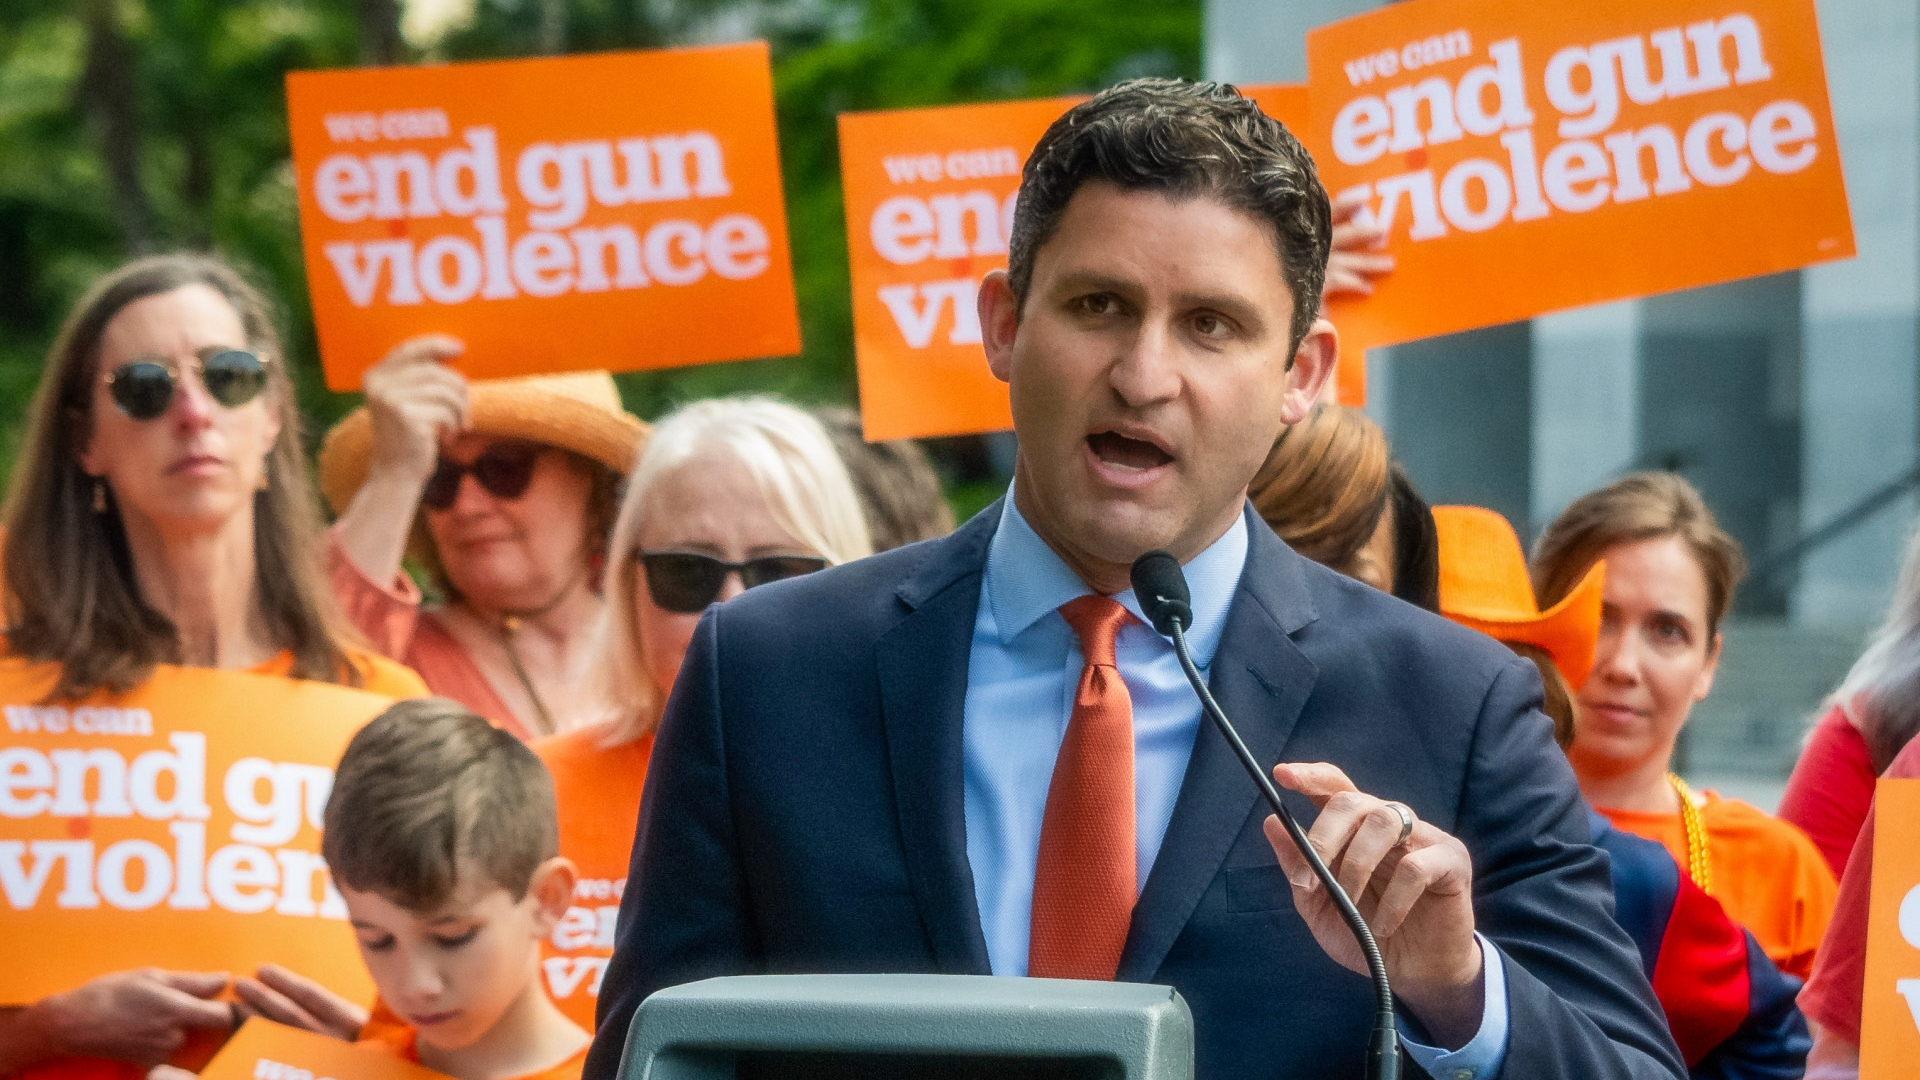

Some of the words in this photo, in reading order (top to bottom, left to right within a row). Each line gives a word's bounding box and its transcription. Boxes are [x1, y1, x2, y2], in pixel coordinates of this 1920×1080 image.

[1331, 38, 1534, 165] end
[1544, 13, 1772, 138] gun
[1342, 48, 1399, 86] we
[1401, 28, 1472, 70] can
[323, 111, 378, 141] we
[380, 107, 449, 139] can
[882, 154, 942, 183] we
[946, 147, 1019, 180] can
[314, 127, 506, 221] end
[516, 131, 731, 229] gun
[1336, 99, 1818, 248] violence
[323, 214, 770, 306] violence
[870, 190, 1018, 265] en
[4, 705, 69, 733] we
[73, 706, 154, 736] can
[0, 731, 210, 820] end
[0, 819, 349, 920] violen
